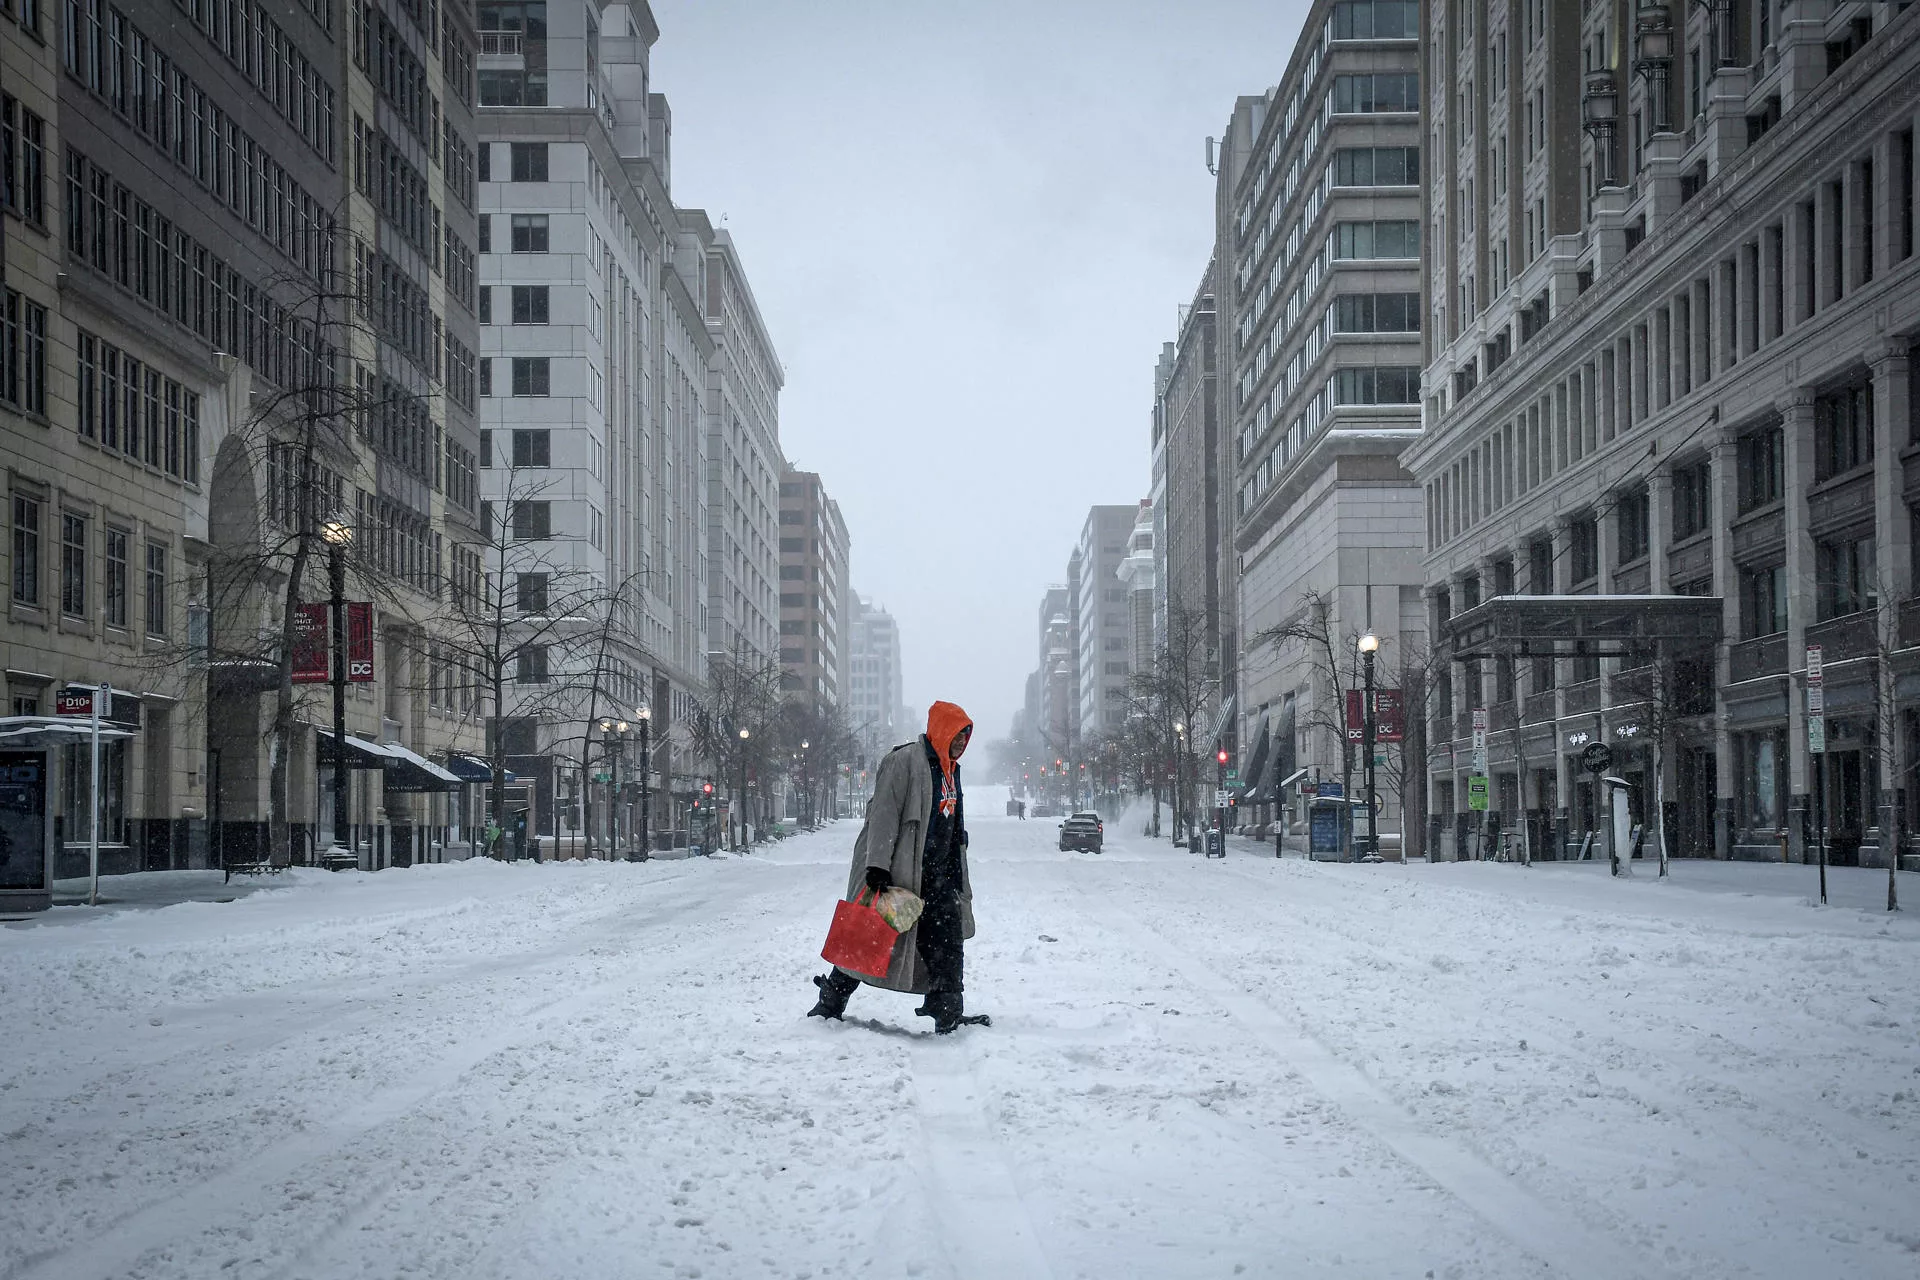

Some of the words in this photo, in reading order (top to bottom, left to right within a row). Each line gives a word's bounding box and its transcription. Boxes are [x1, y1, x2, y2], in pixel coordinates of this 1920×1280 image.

[351, 663, 371, 675] DC
[66, 697, 86, 707] D10
[1378, 726, 1392, 734] DC
